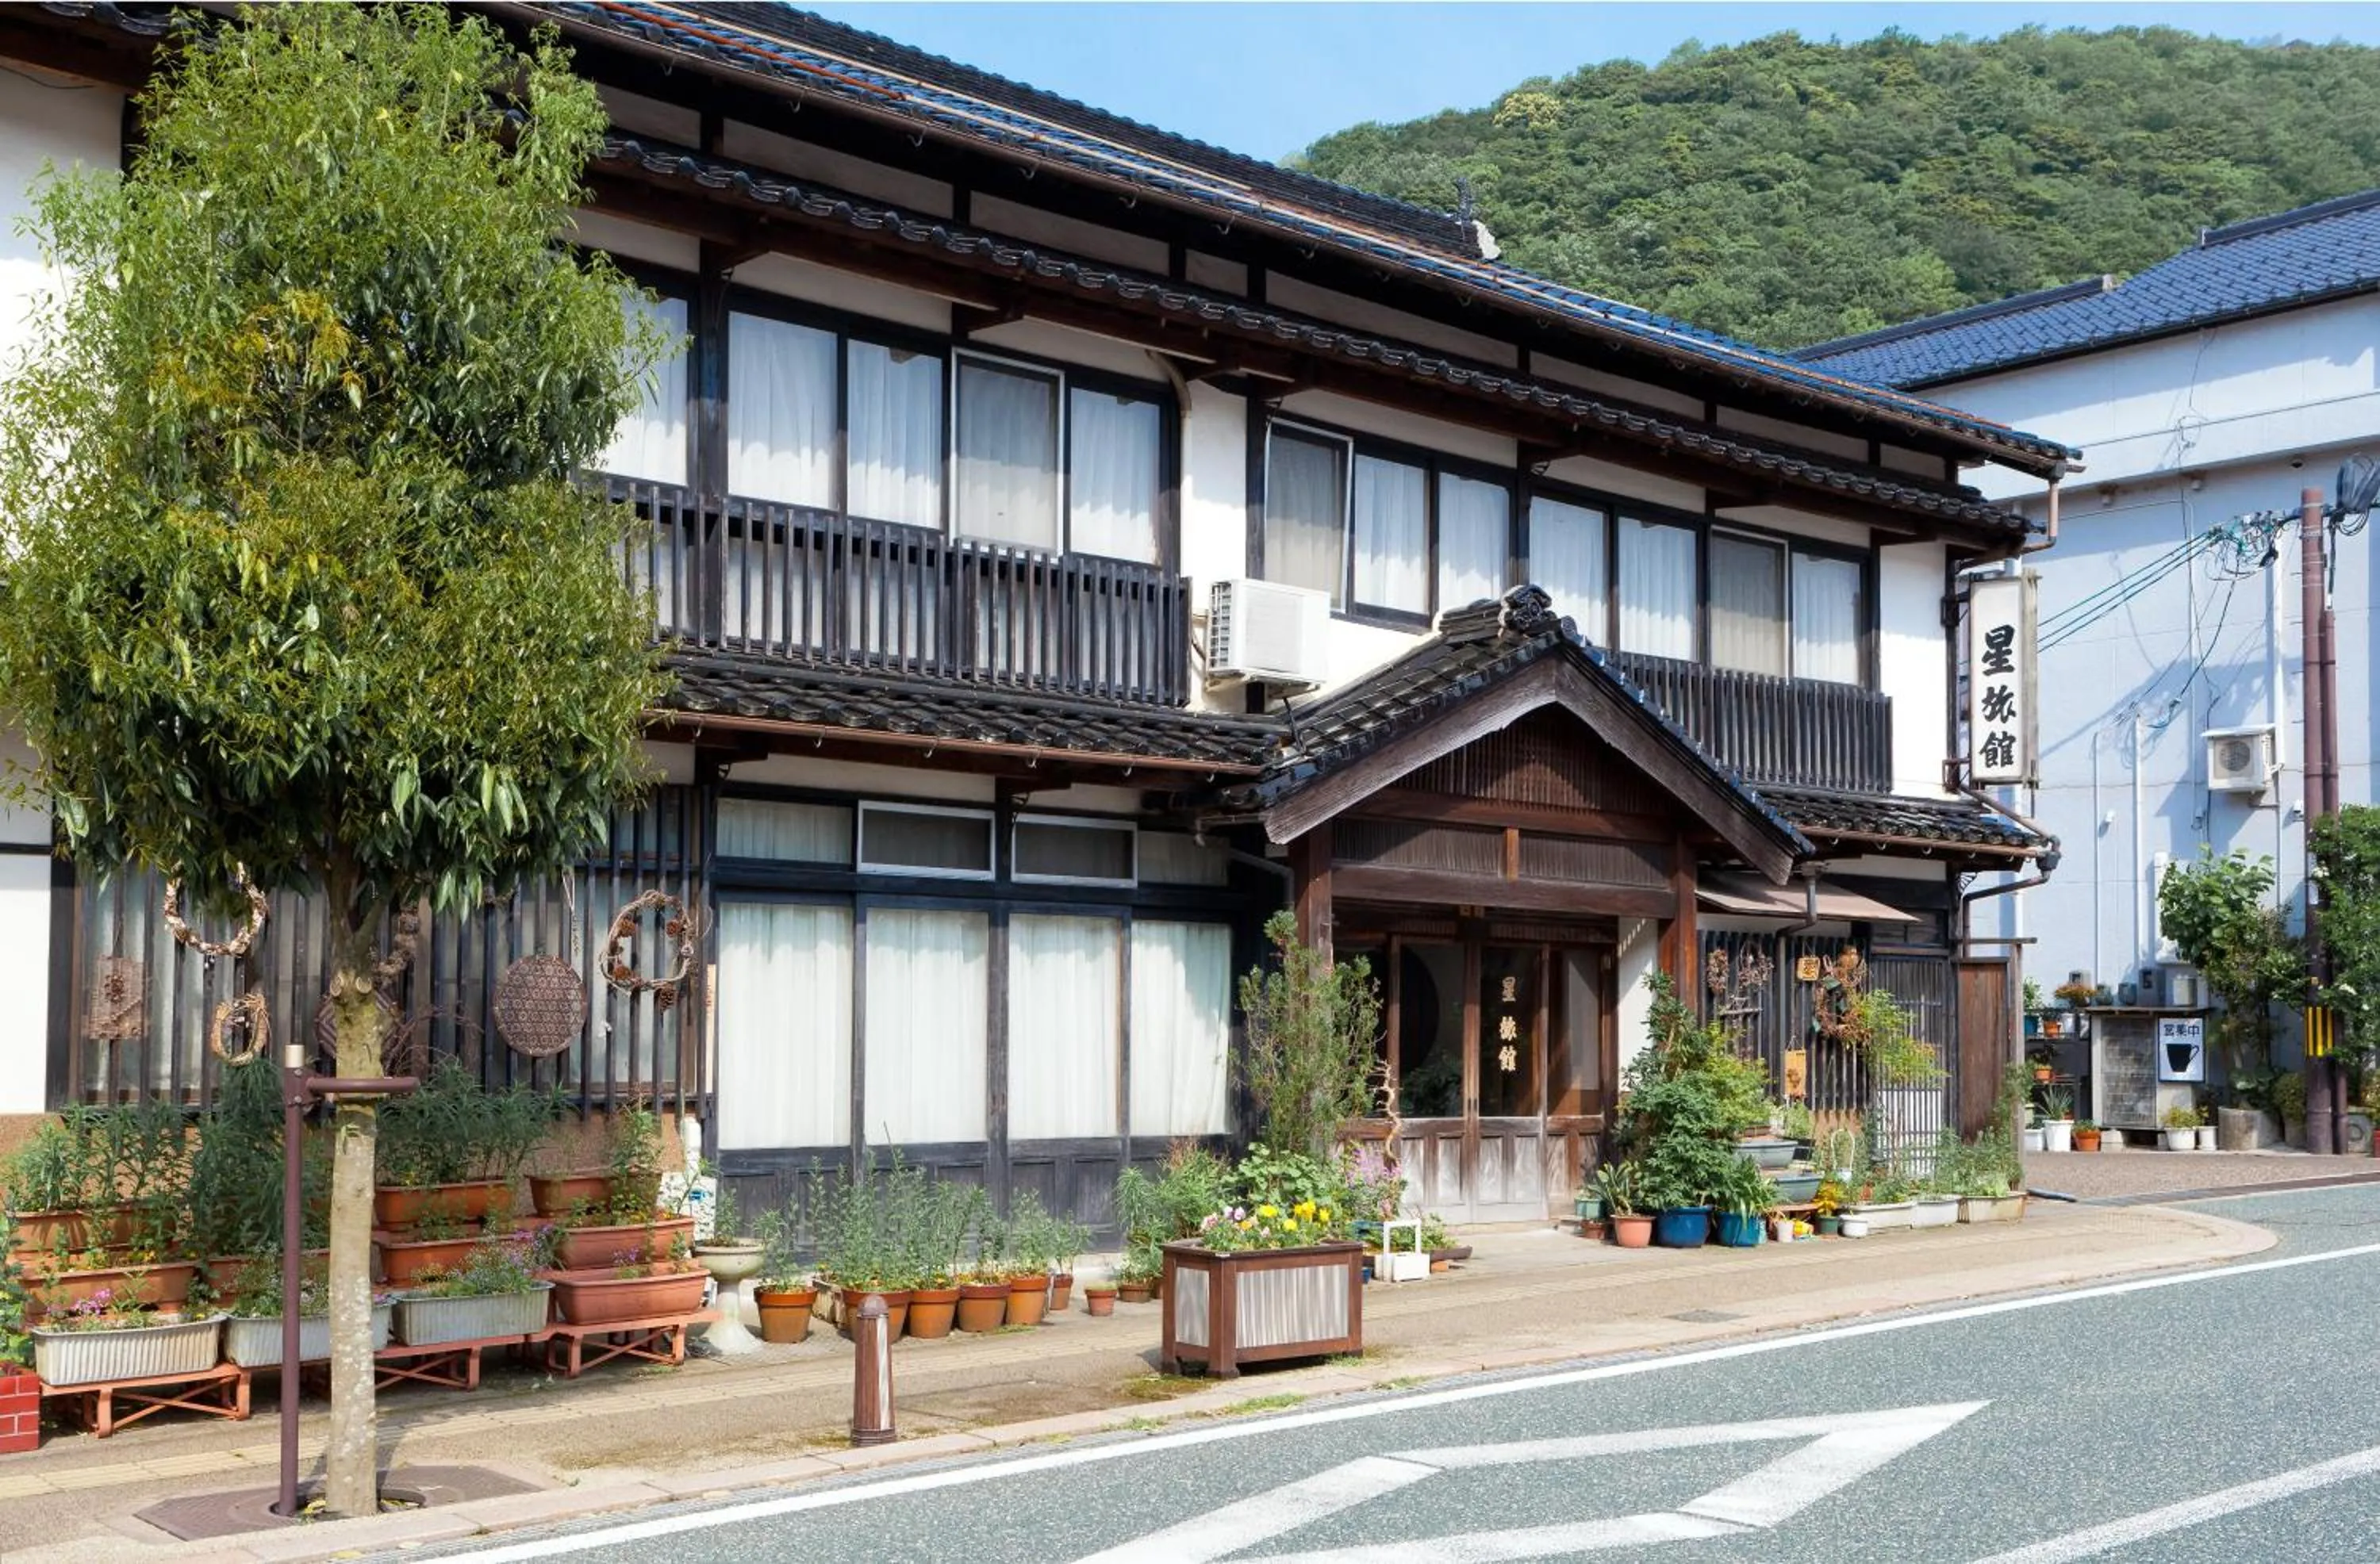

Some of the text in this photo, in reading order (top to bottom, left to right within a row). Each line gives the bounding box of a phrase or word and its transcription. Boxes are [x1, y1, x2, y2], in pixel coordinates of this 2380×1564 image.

[1979, 624, 2016, 768] 星旅館
[1499, 976, 1517, 1071] 星旅館
[2163, 1024, 2200, 1037] 営業中
